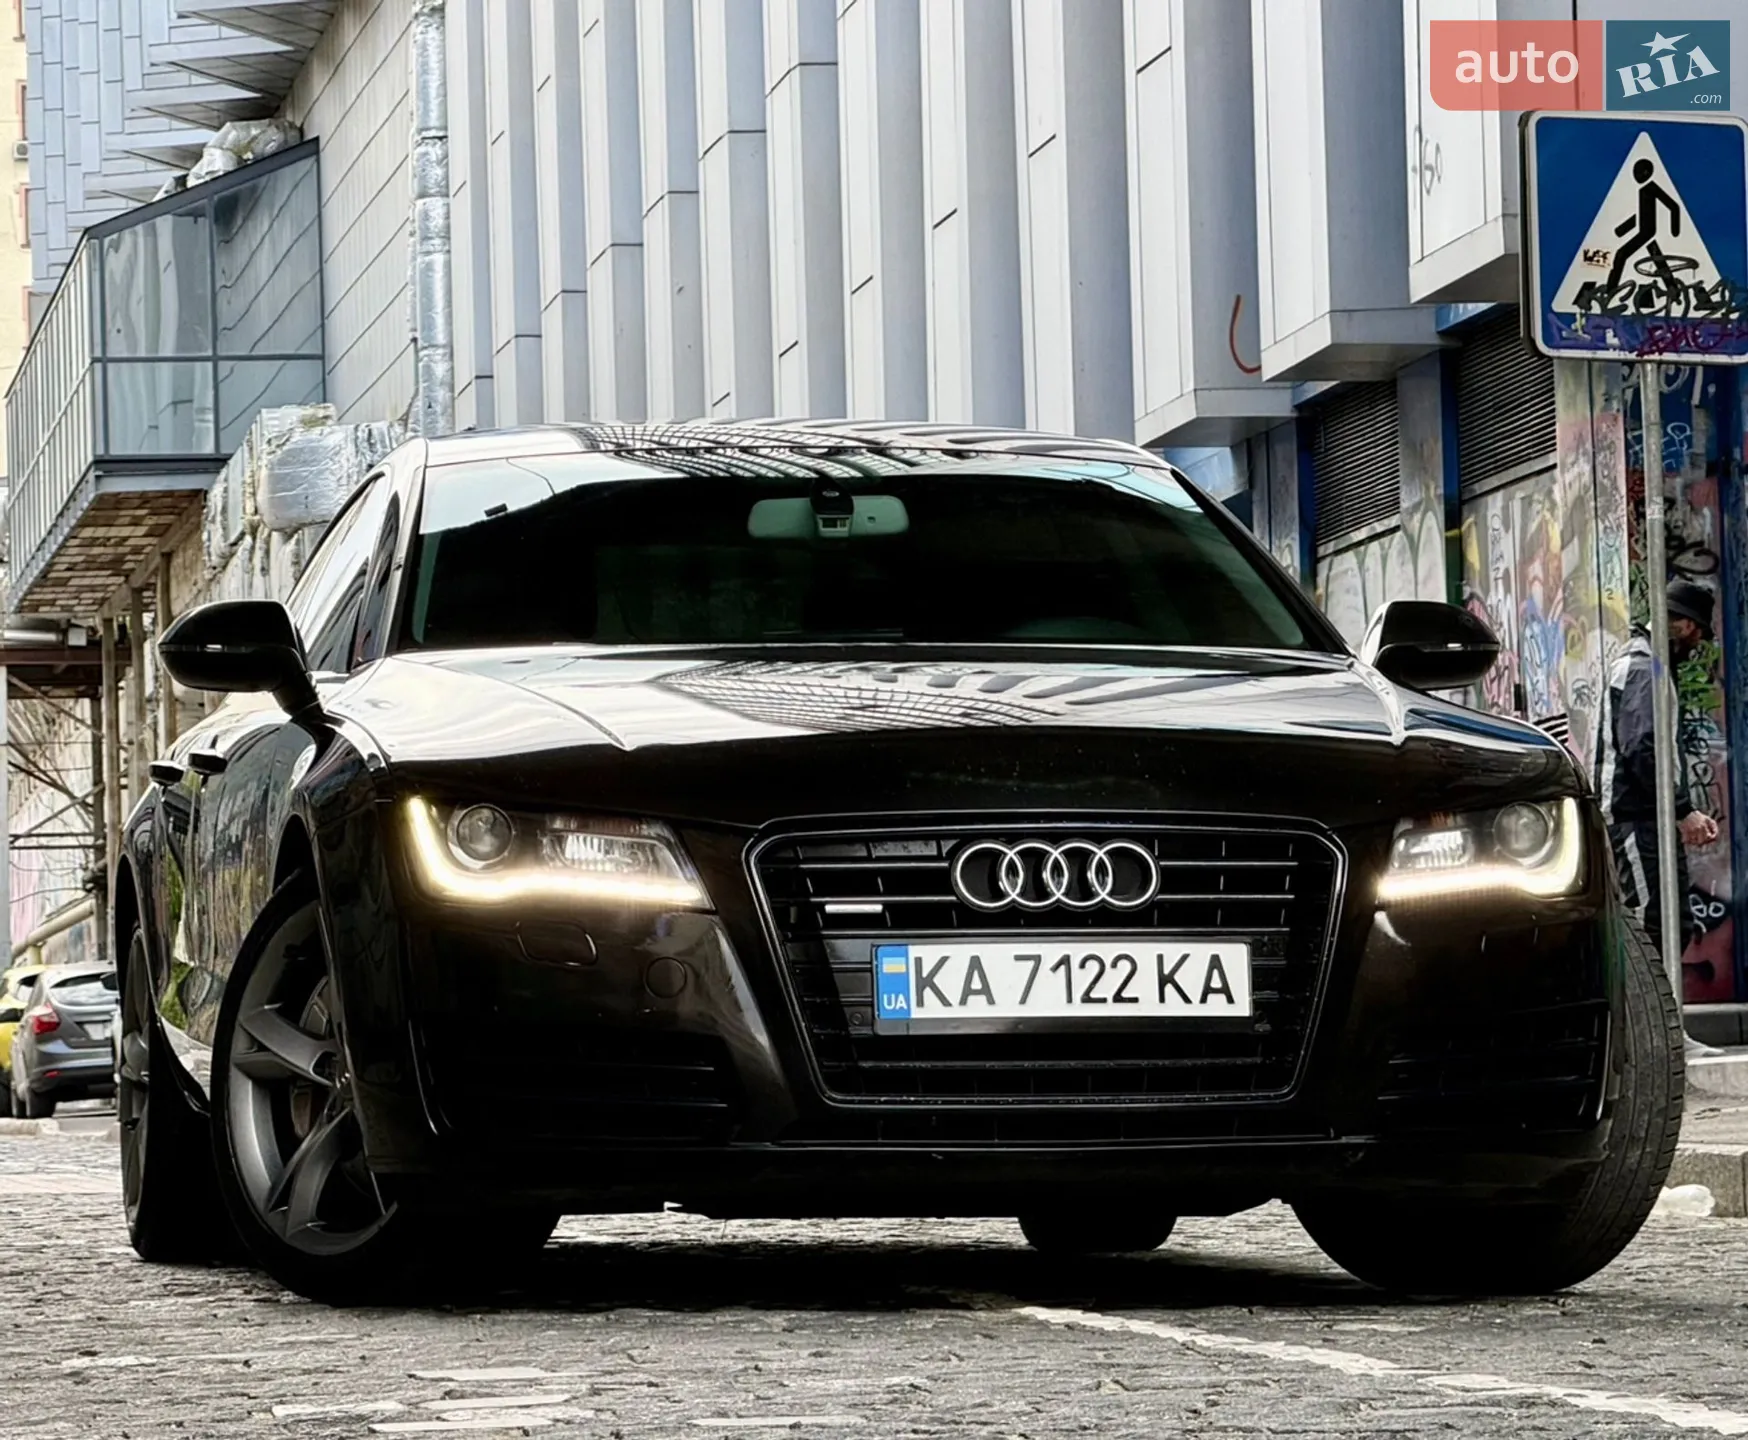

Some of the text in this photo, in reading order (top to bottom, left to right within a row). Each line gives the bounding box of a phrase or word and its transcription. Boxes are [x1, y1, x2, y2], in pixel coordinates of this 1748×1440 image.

[914, 953, 1235, 1008] KA 7122 KA
[883, 994, 907, 1010] UA
